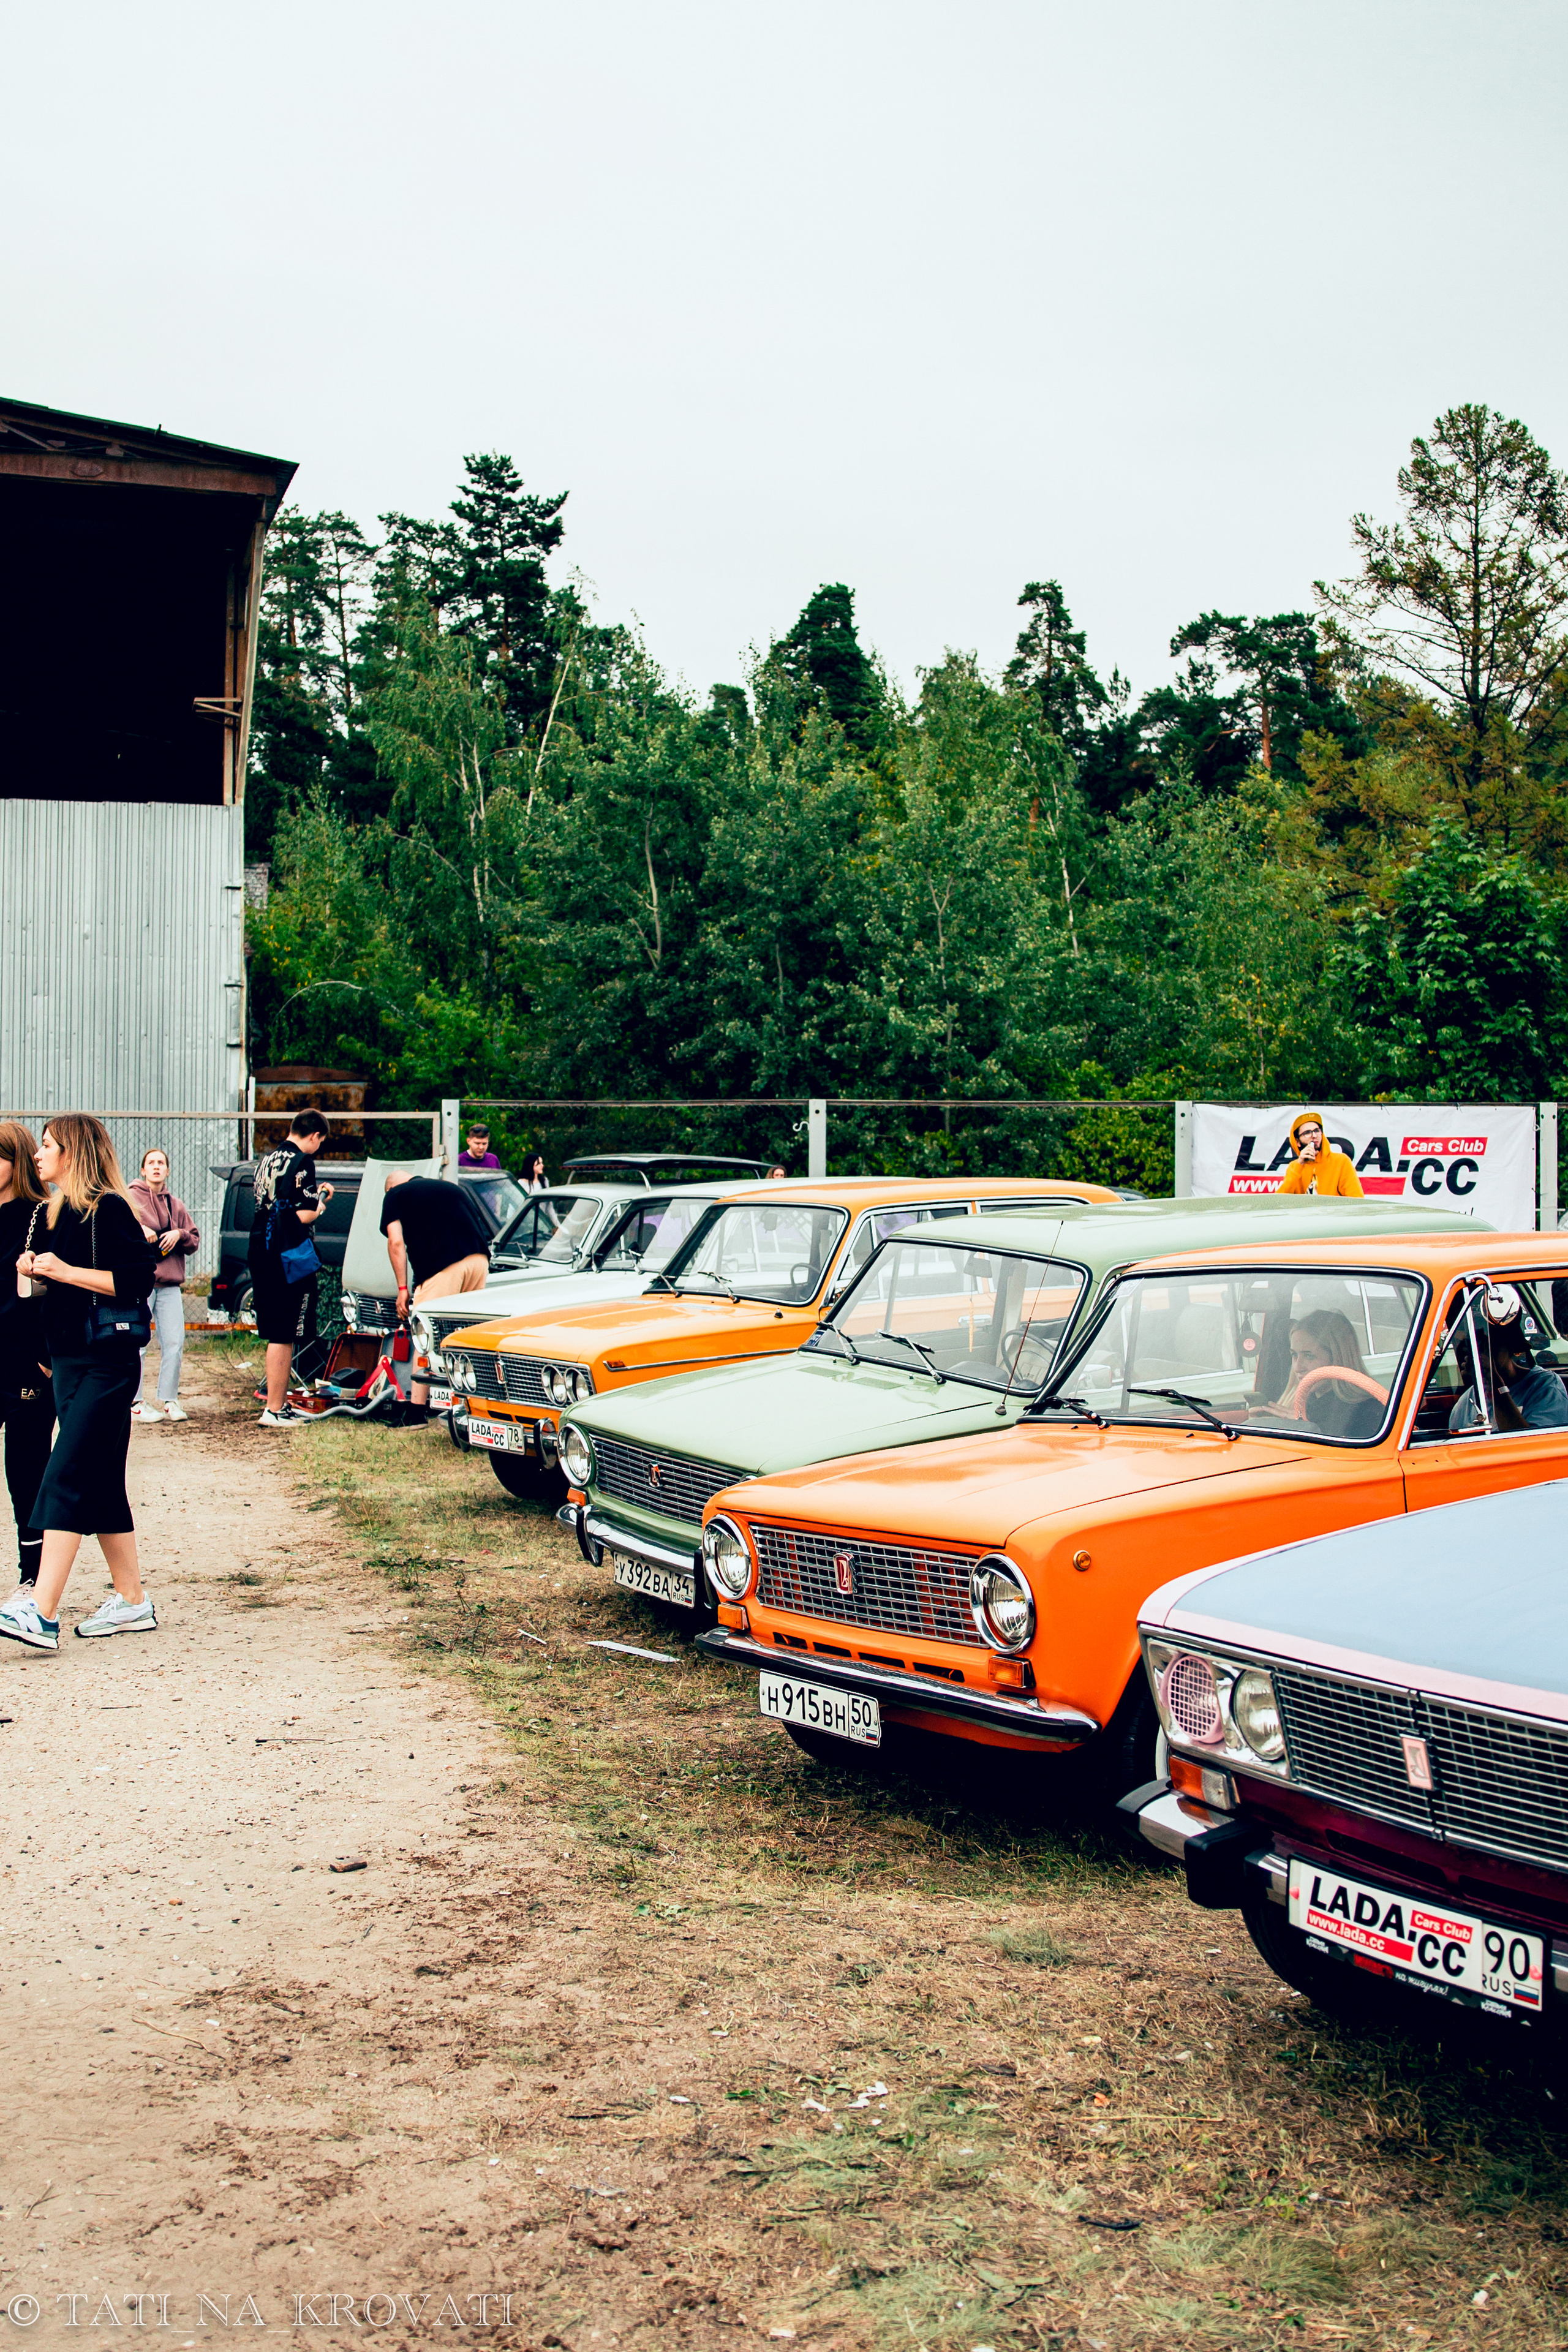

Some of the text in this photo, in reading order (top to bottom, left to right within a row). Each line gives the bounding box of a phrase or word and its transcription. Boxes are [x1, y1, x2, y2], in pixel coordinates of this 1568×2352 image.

[1407, 1139, 1484, 1153] Cars Club
[508, 1428, 519, 1442] 78
[674, 1572, 690, 1595] 34
[673, 1592, 685, 1602] RUS
[851, 1697, 872, 1727] 50
[851, 1725, 866, 1738] RUS
[1308, 1912, 1385, 1951] www.lada.cc
[1414, 1913, 1471, 1940] Cars Club
[1484, 1931, 1530, 1981] 90
[1482, 1973, 1512, 1996] RUS
